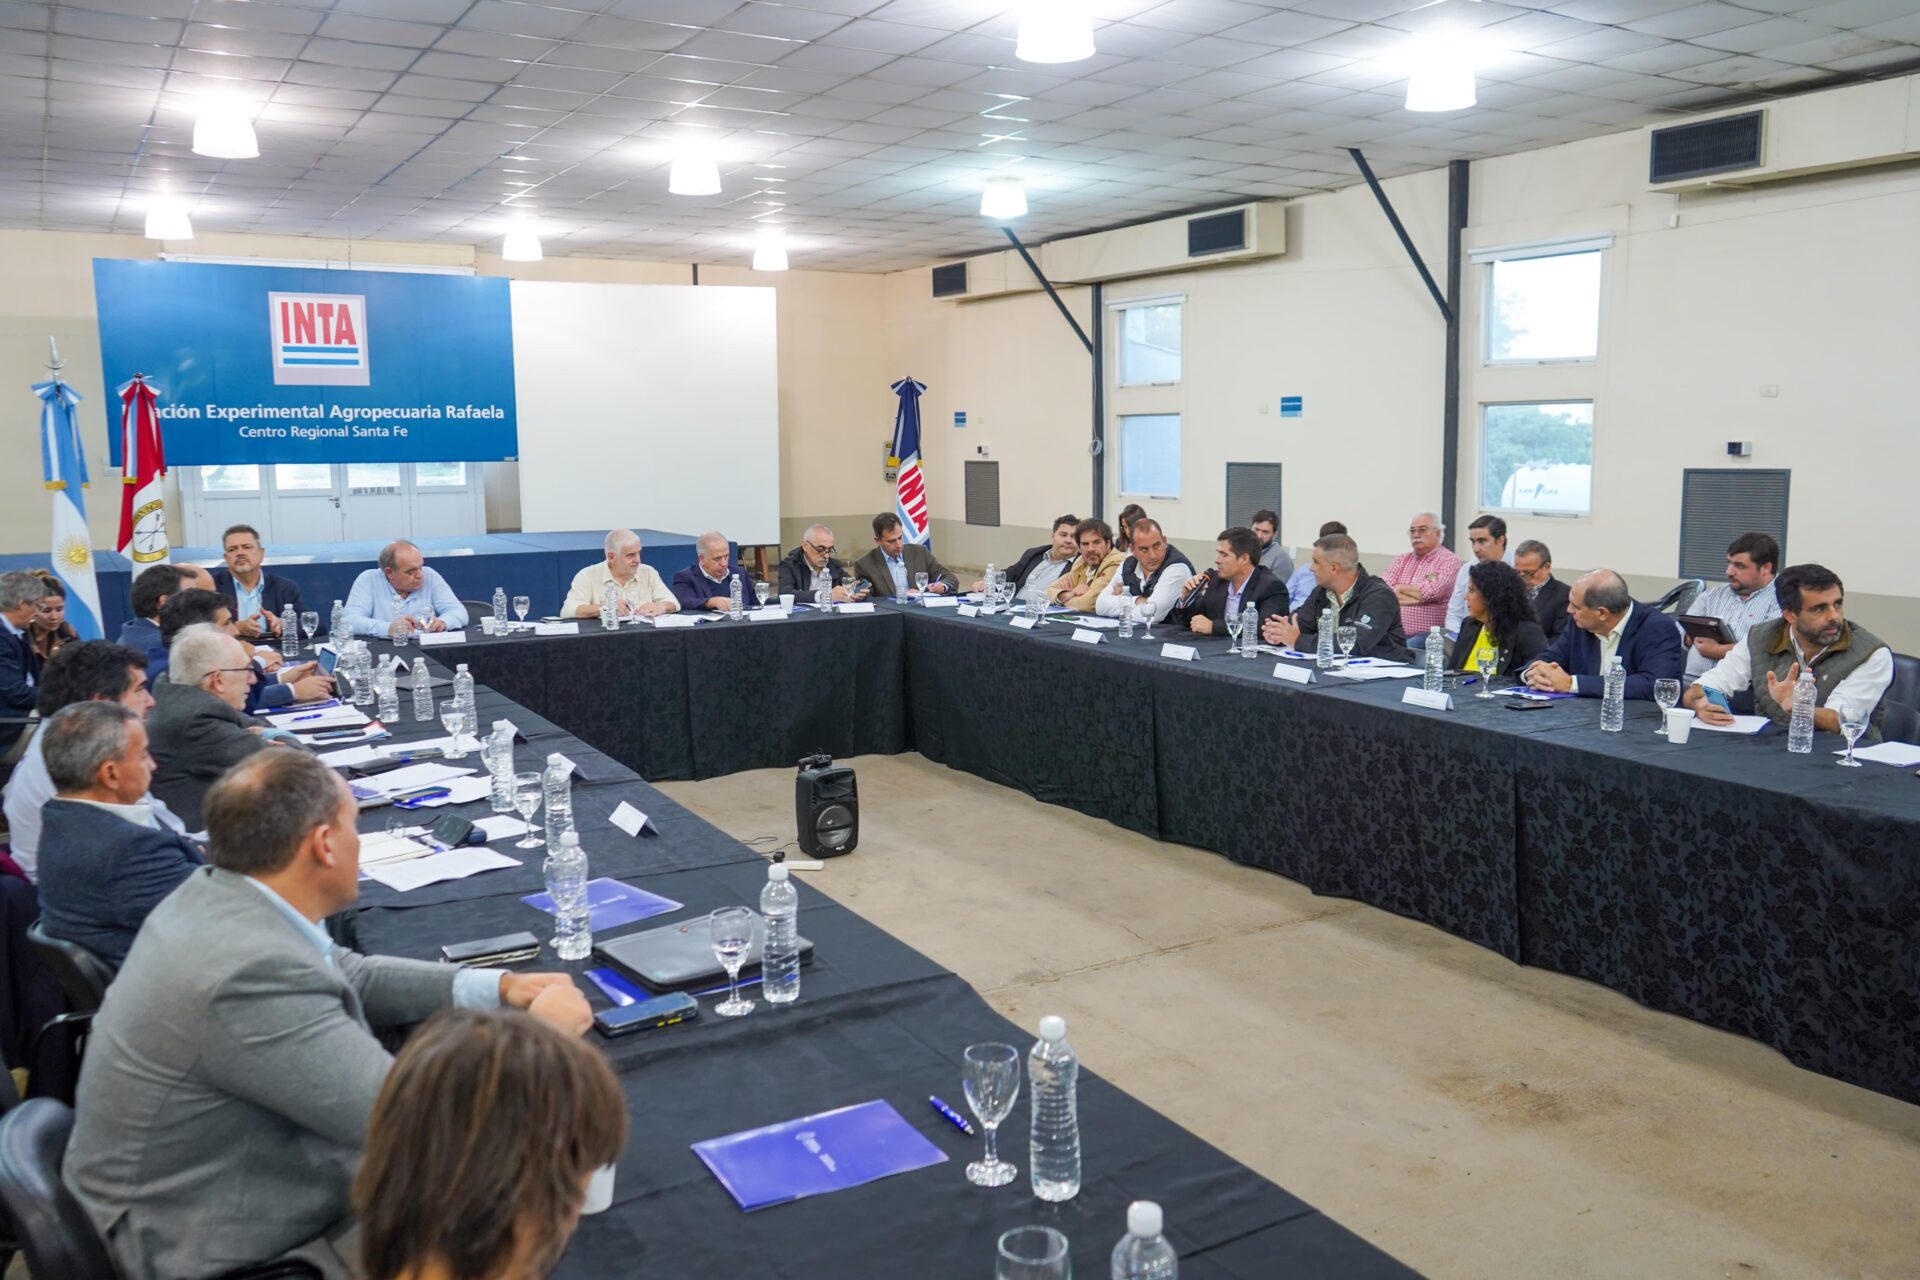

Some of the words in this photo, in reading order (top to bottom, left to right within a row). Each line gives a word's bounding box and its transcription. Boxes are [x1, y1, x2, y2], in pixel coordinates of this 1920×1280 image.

[281, 301, 357, 345] INTA
[122, 403, 200, 419] ación
[206, 404, 324, 422] Experimental
[329, 404, 441, 422] Agropecuaria
[446, 404, 504, 419] Rafaela
[239, 426, 287, 437] Centro
[290, 425, 348, 440] Regional
[352, 425, 389, 437] Santa
[392, 426, 408, 437] Fe
[898, 465, 928, 534] INTA
